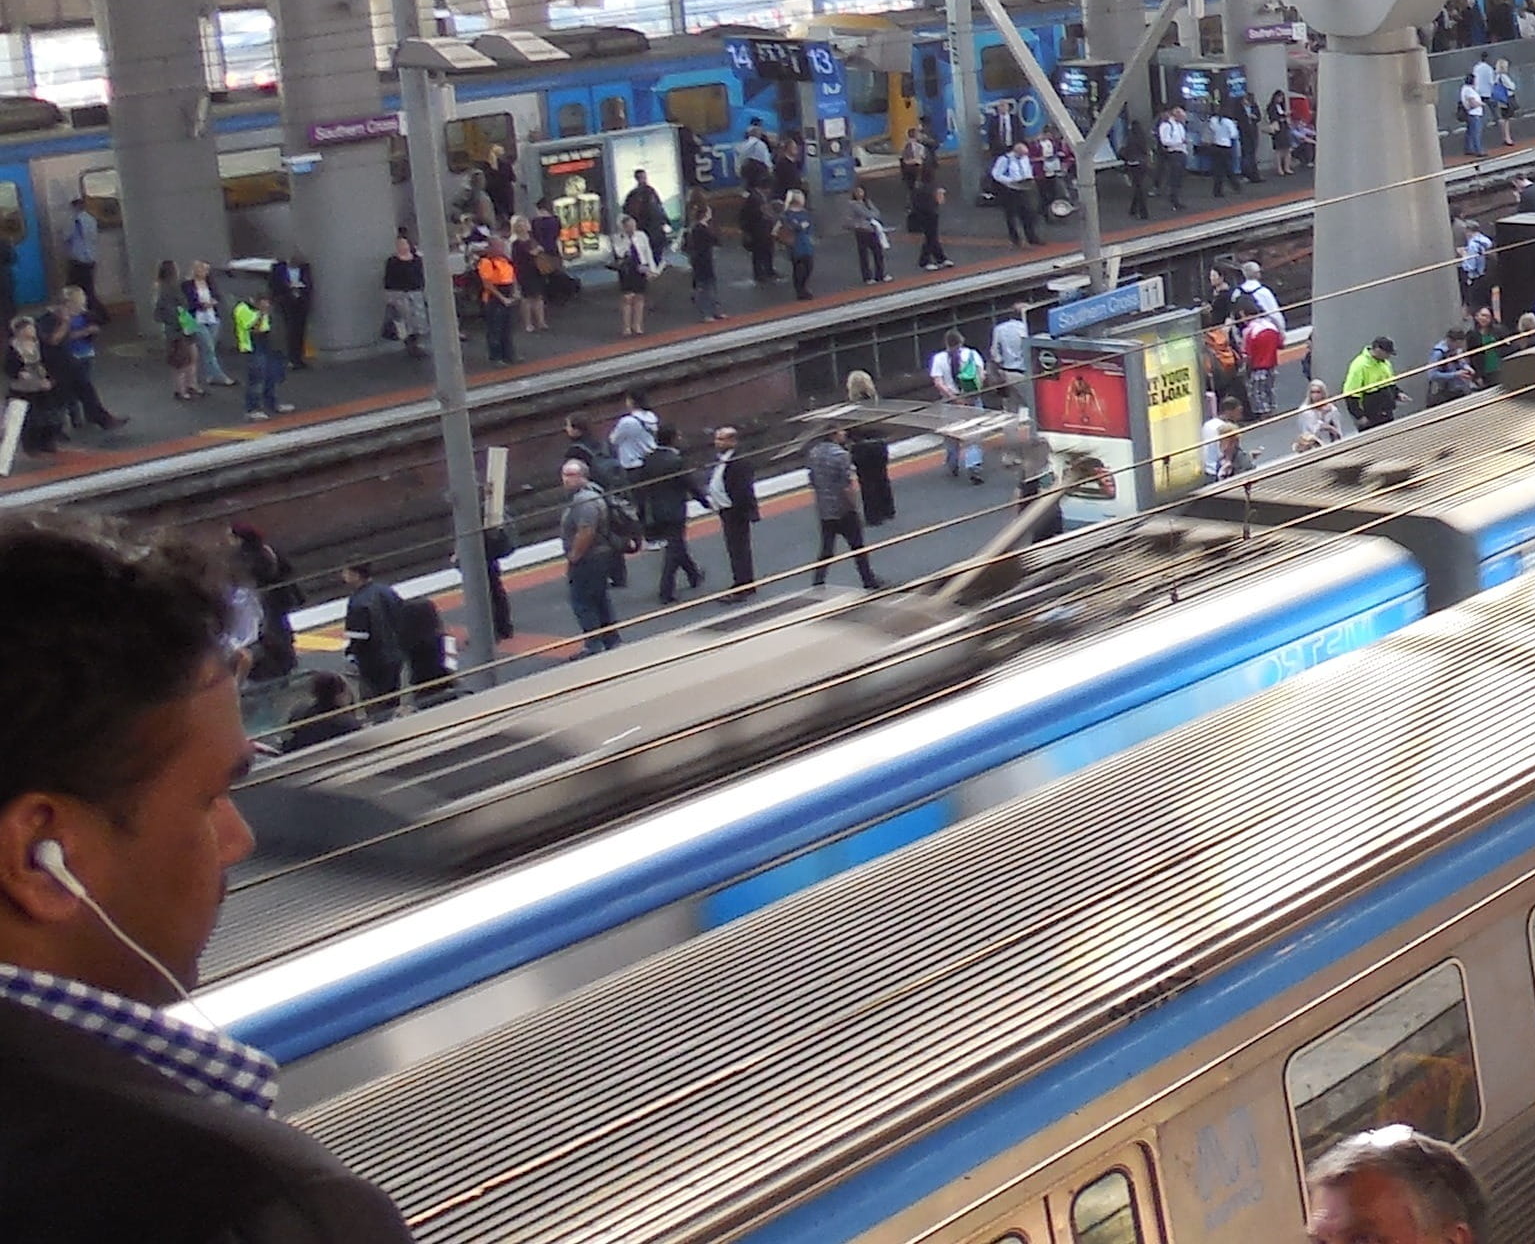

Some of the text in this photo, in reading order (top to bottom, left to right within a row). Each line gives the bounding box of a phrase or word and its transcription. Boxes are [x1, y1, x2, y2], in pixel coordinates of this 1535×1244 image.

[727, 44, 752, 70] 14
[807, 49, 832, 74] 13
[314, 124, 365, 141] Southern
[1058, 303, 1106, 329] Southern
[1107, 293, 1140, 313] Cross
[1161, 367, 1190, 387] YOUR
